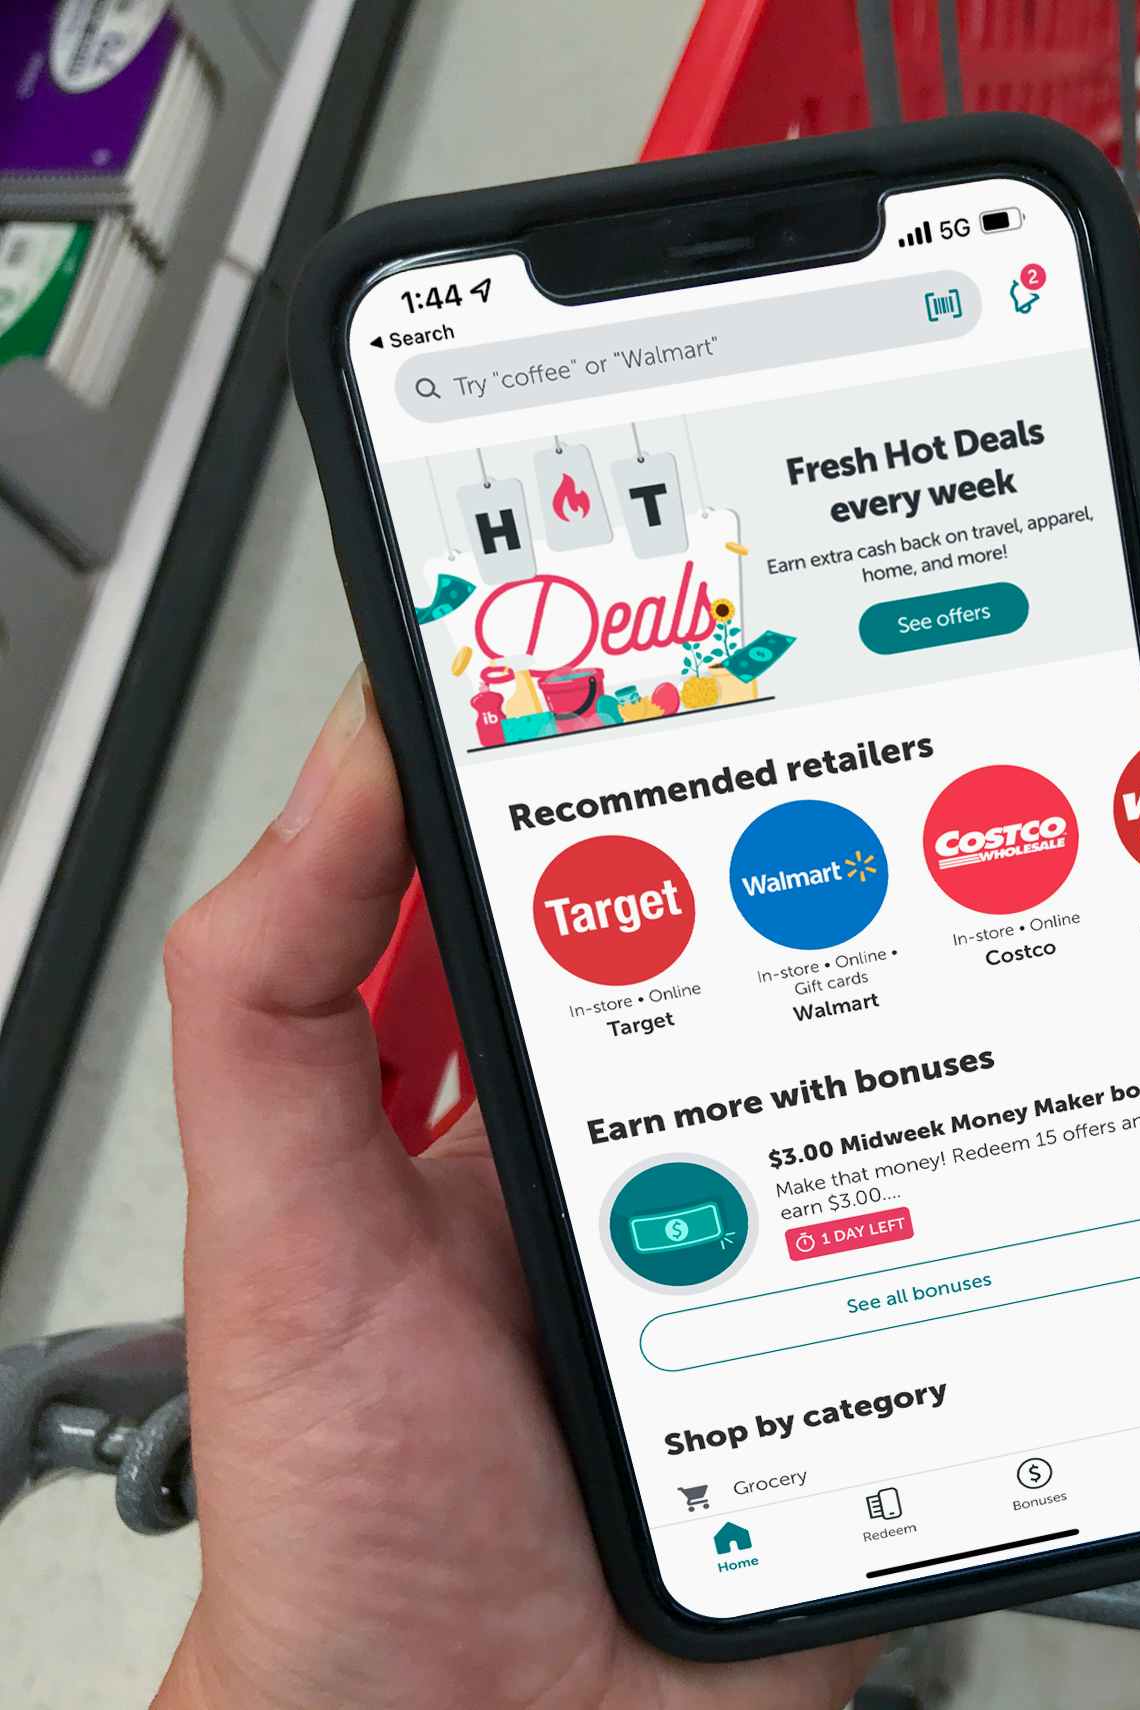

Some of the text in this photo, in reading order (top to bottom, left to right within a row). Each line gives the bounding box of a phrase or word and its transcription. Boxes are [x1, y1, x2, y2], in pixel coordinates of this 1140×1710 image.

[401, 218, 970, 313] 1:44 5G
[1027, 269, 1040, 285] 2
[390, 325, 455, 348] Search
[453, 376, 487, 398] Try
[585, 357, 608, 376] or
[787, 420, 1045, 485] Fresh Hot Deals
[830, 469, 1017, 522] every week
[767, 506, 1094, 575] Earn extra cash back on travel, apparel,
[862, 544, 1008, 583] home, and more!
[475, 561, 717, 677] Deals
[898, 604, 991, 634] See offers
[483, 712, 498, 726] ib
[509, 737, 934, 831] Recommended retailers
[934, 816, 1067, 857] COSTCO
[978, 837, 1066, 864] WHOLESALE
[742, 861, 842, 897] Walmart
[544, 879, 683, 936] Target
[953, 912, 1081, 946] In-store Online
[757, 948, 887, 984] In-store Online
[986, 942, 1056, 966] Costco
[569, 982, 702, 1018] In-store Online
[794, 970, 869, 996] Gift cards
[607, 1011, 676, 1038] Target
[793, 993, 880, 1022] Walmart
[587, 1051, 995, 1144] Earn more with bonuses
[768, 1141, 833, 1169] $3.00
[841, 1120, 945, 1152] Midweek
[951, 1106, 1028, 1134] Money
[1034, 1090, 1105, 1117] Maker
[776, 1173, 826, 1198] Make
[831, 1166, 869, 1187] that
[875, 1153, 946, 1180] money!
[952, 1136, 1030, 1163] Redeem
[1036, 1130, 1057, 1147] 15
[1063, 1121, 1116, 1142] offers
[781, 1199, 822, 1220] earn
[821, 1216, 905, 1245] 1 DAY LEFT
[848, 1274, 992, 1313] See all bonuses
[664, 1383, 947, 1455] Shop by category
[733, 1471, 807, 1495] Grocery
[717, 1557, 759, 1573] Home
[862, 1523, 918, 1542] Redeem
[1012, 1491, 1067, 1511] Bonuses
